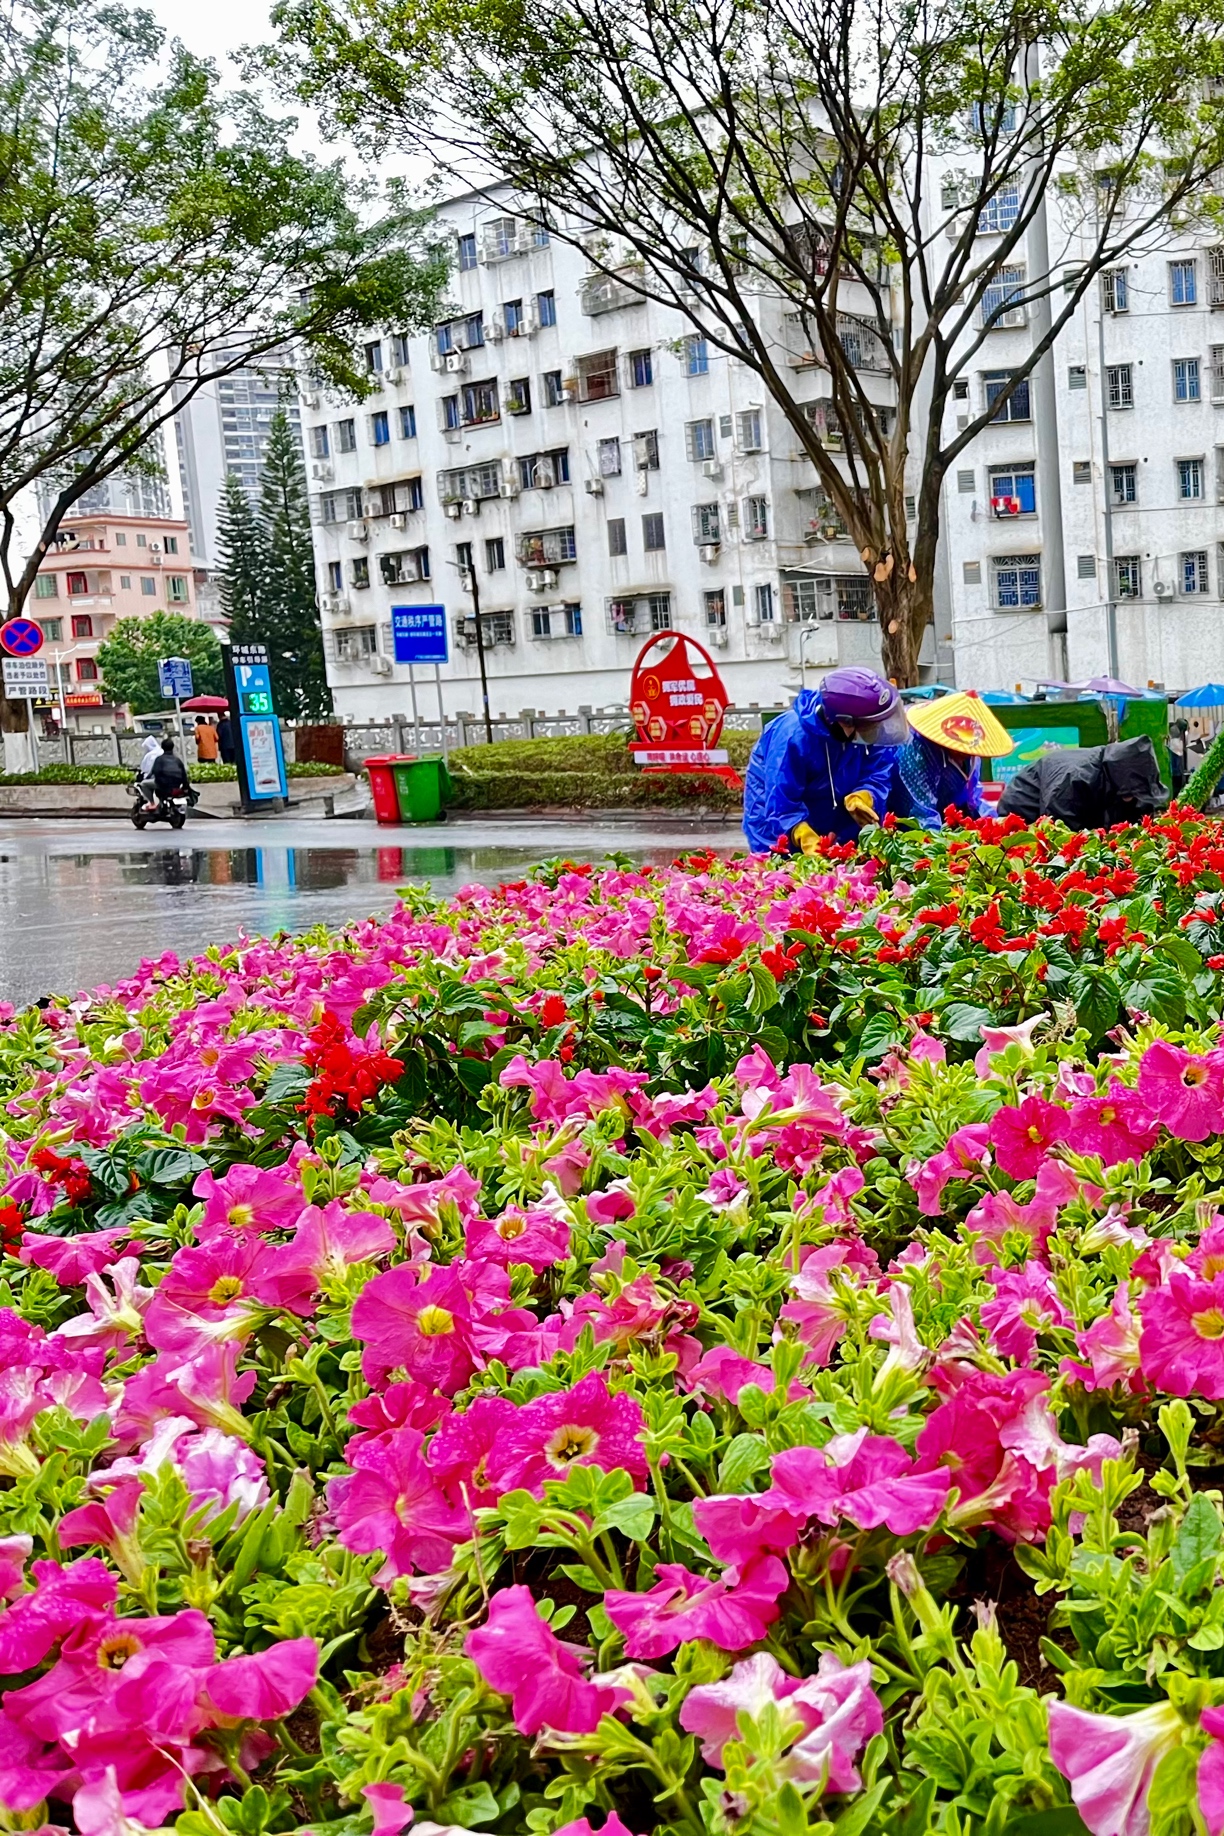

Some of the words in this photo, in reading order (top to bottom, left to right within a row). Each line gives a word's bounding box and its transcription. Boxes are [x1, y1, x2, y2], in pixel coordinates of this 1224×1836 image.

[8, 686, 48, 695] 严管路段
[248, 692, 269, 712] 35
